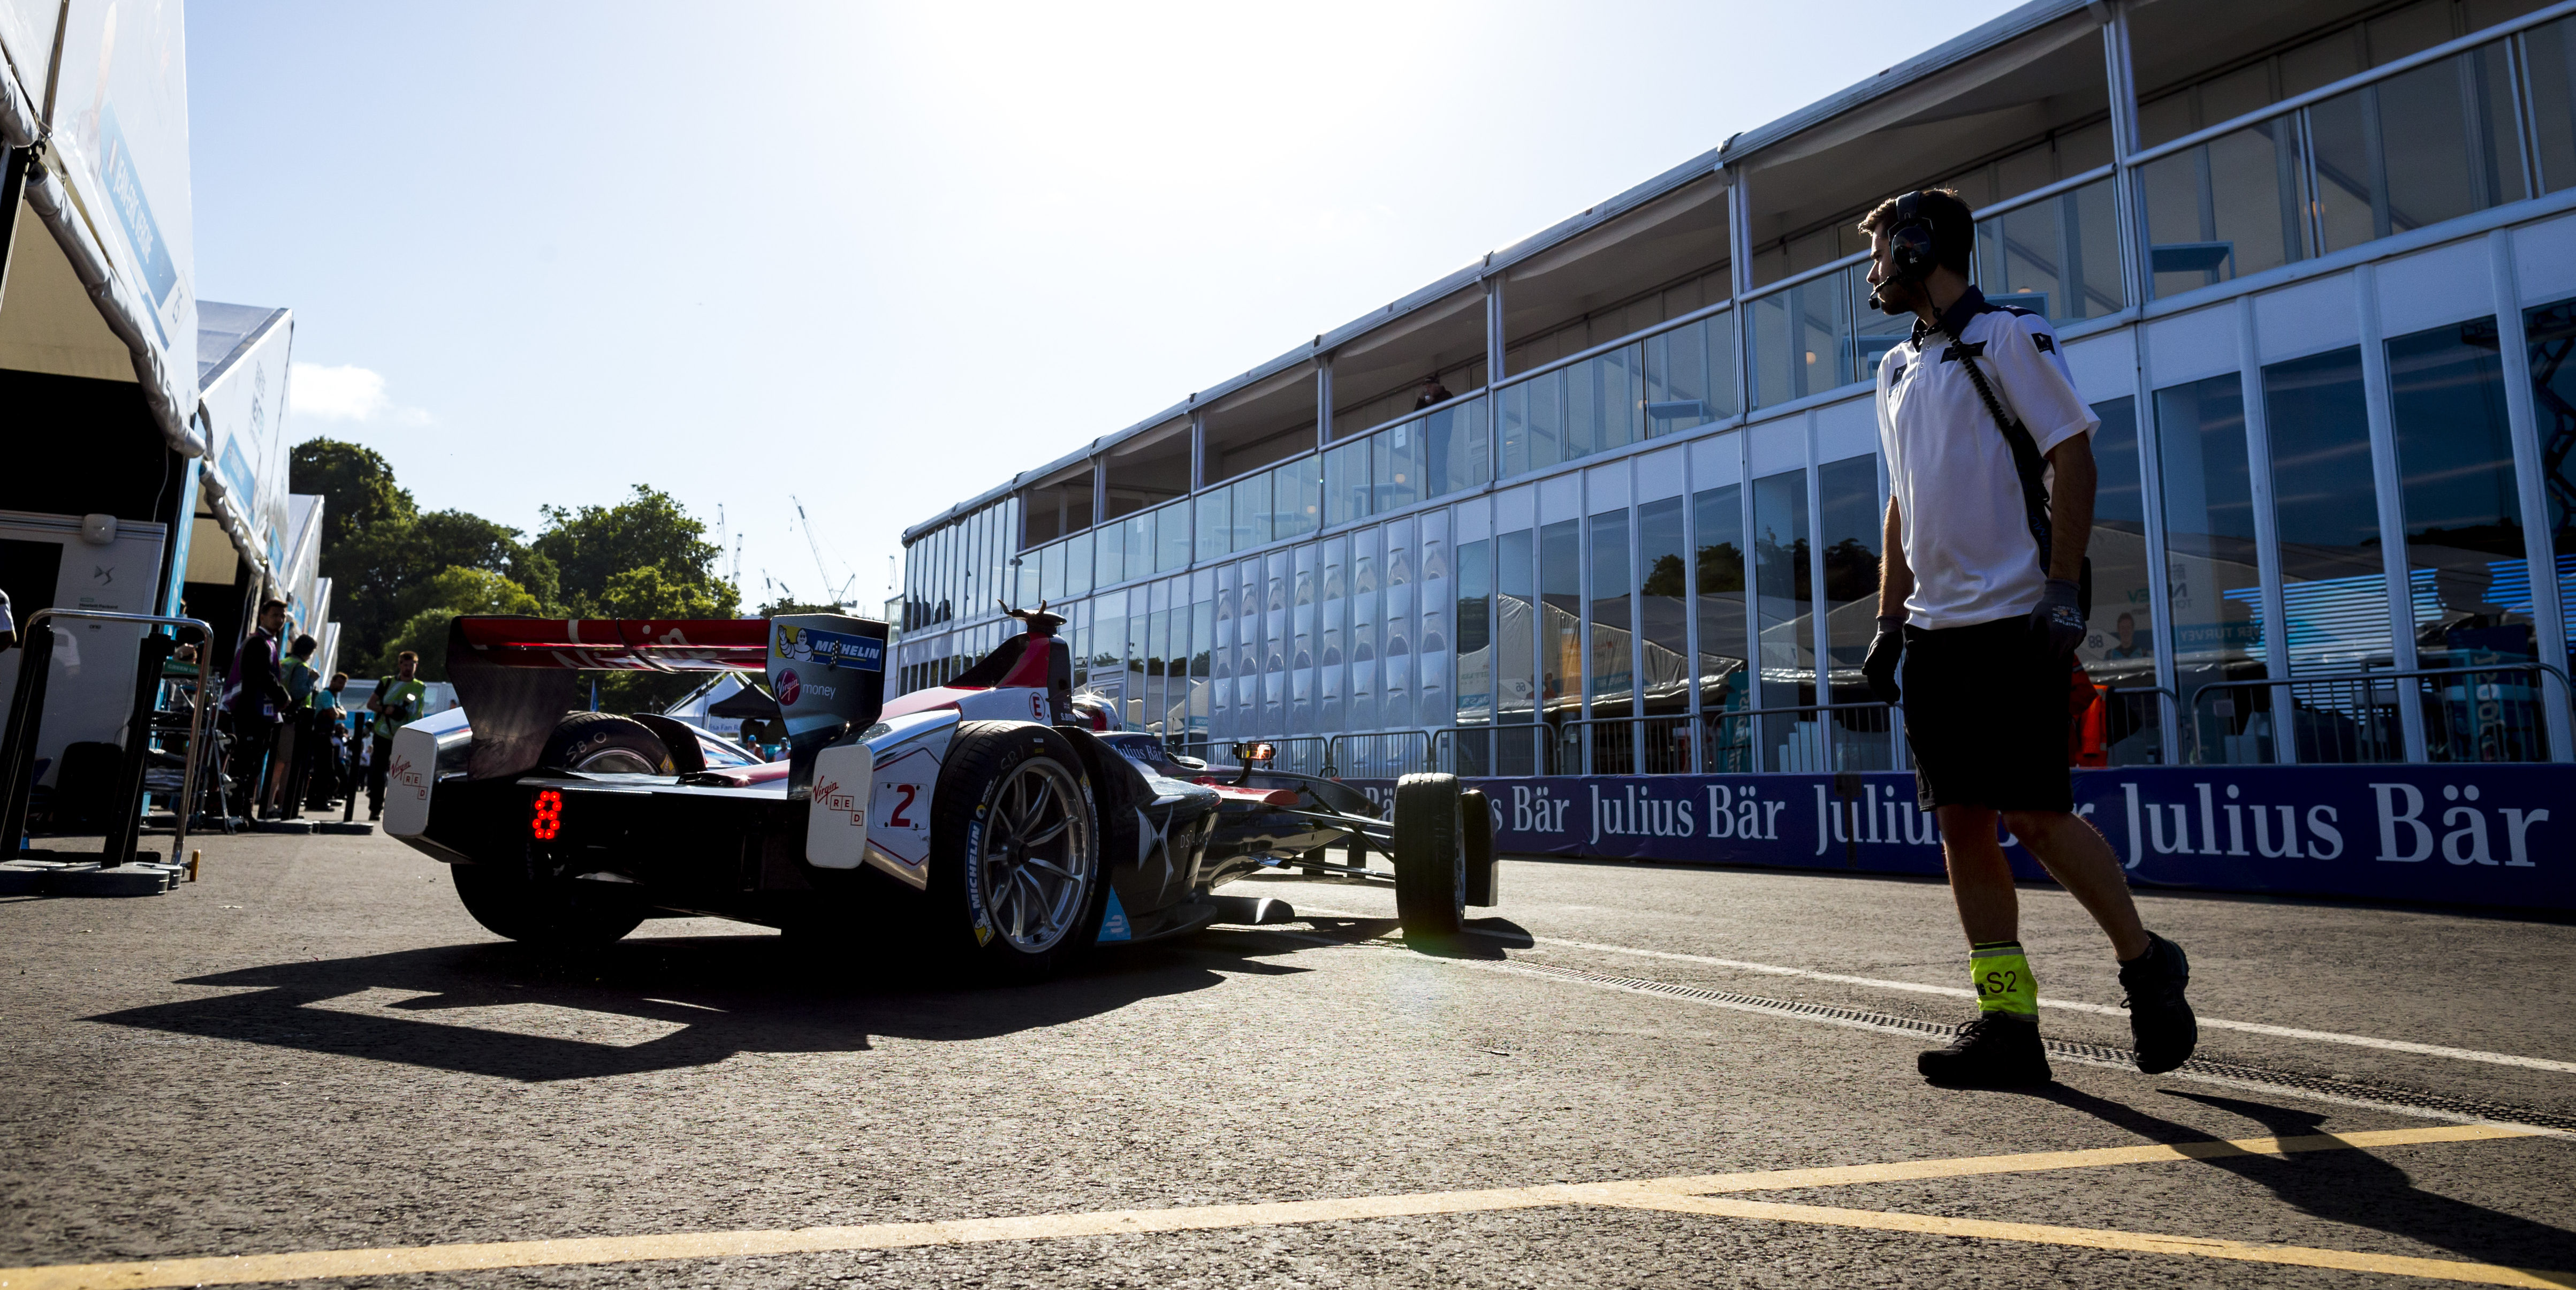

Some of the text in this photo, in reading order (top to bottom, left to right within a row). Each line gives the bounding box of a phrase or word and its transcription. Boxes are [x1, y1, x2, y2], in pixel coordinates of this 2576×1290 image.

[777, 672, 837, 702] Virgin money
[390, 755, 412, 781] Virgin
[1145, 745, 1164, 762] Bär
[812, 775, 839, 806] Virgin
[890, 784, 916, 828] 2
[1511, 785, 1570, 833] Bär
[532, 790, 563, 840] 8
[1590, 783, 1786, 845] Julius Bär
[1813, 784, 1940, 856] Juliu
[2119, 783, 2344, 870] Julius
[2368, 783, 2550, 868] Bär
[1180, 833, 1190, 849] DS
[972, 825, 983, 910] MICHELIN
[1986, 970, 2017, 995] S2
